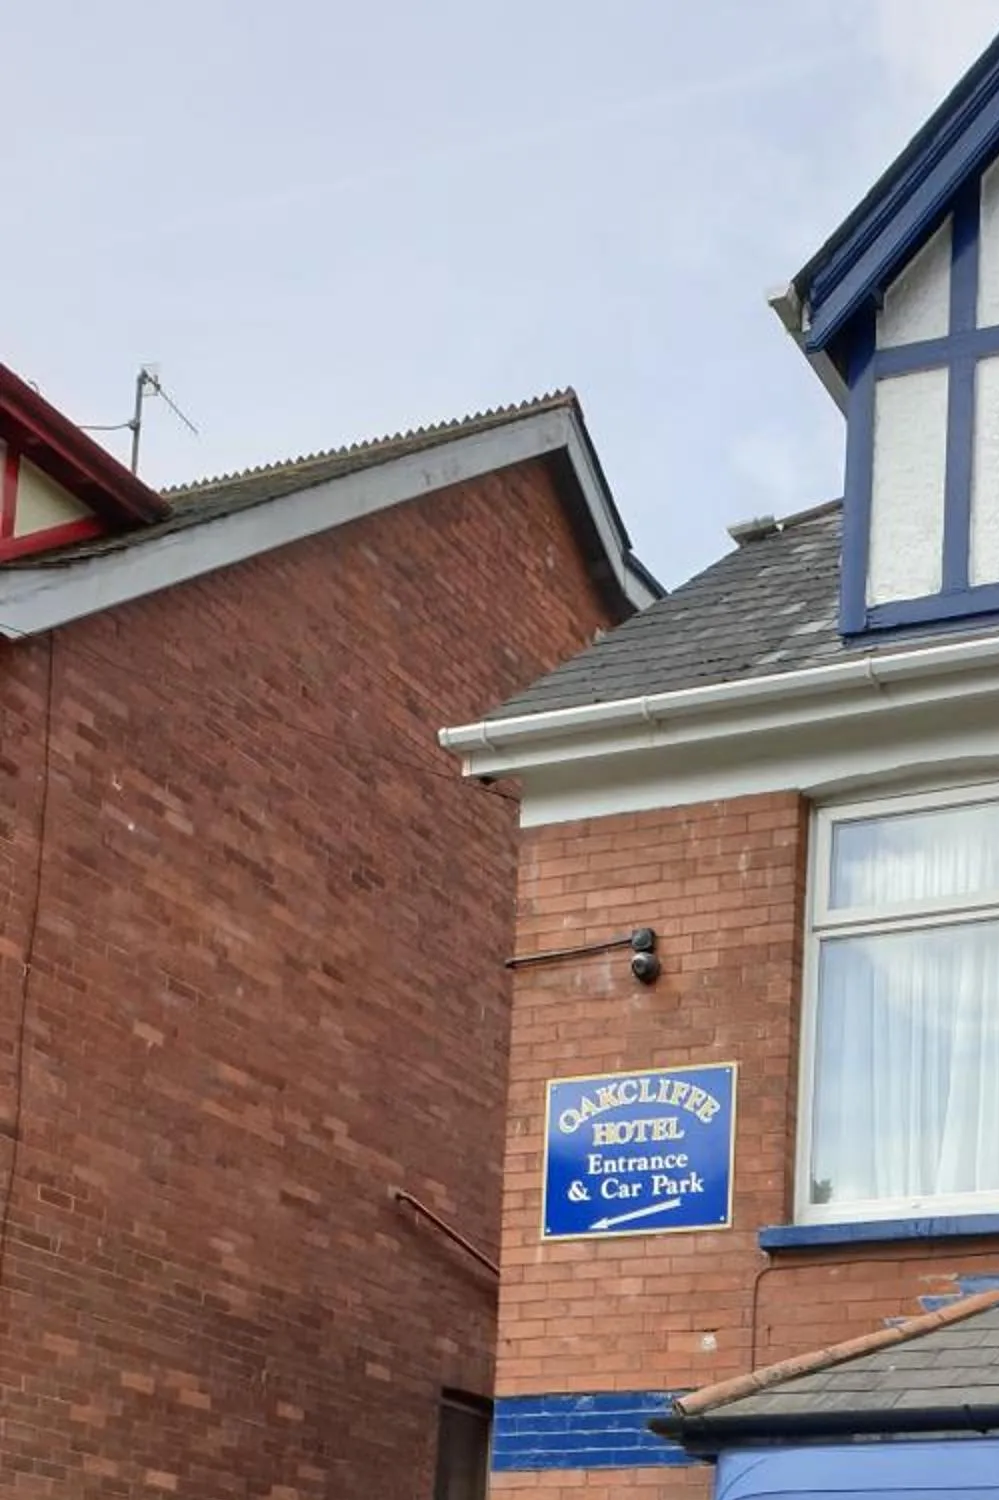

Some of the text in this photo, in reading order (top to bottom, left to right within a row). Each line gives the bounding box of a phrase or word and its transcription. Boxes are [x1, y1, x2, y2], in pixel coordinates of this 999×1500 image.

[559, 1078, 721, 1134] OAKCLIFFE
[592, 1117, 685, 1146] HOTEL
[588, 1153, 688, 1175] Entrance
[567, 1172, 704, 1202] & Car Park
